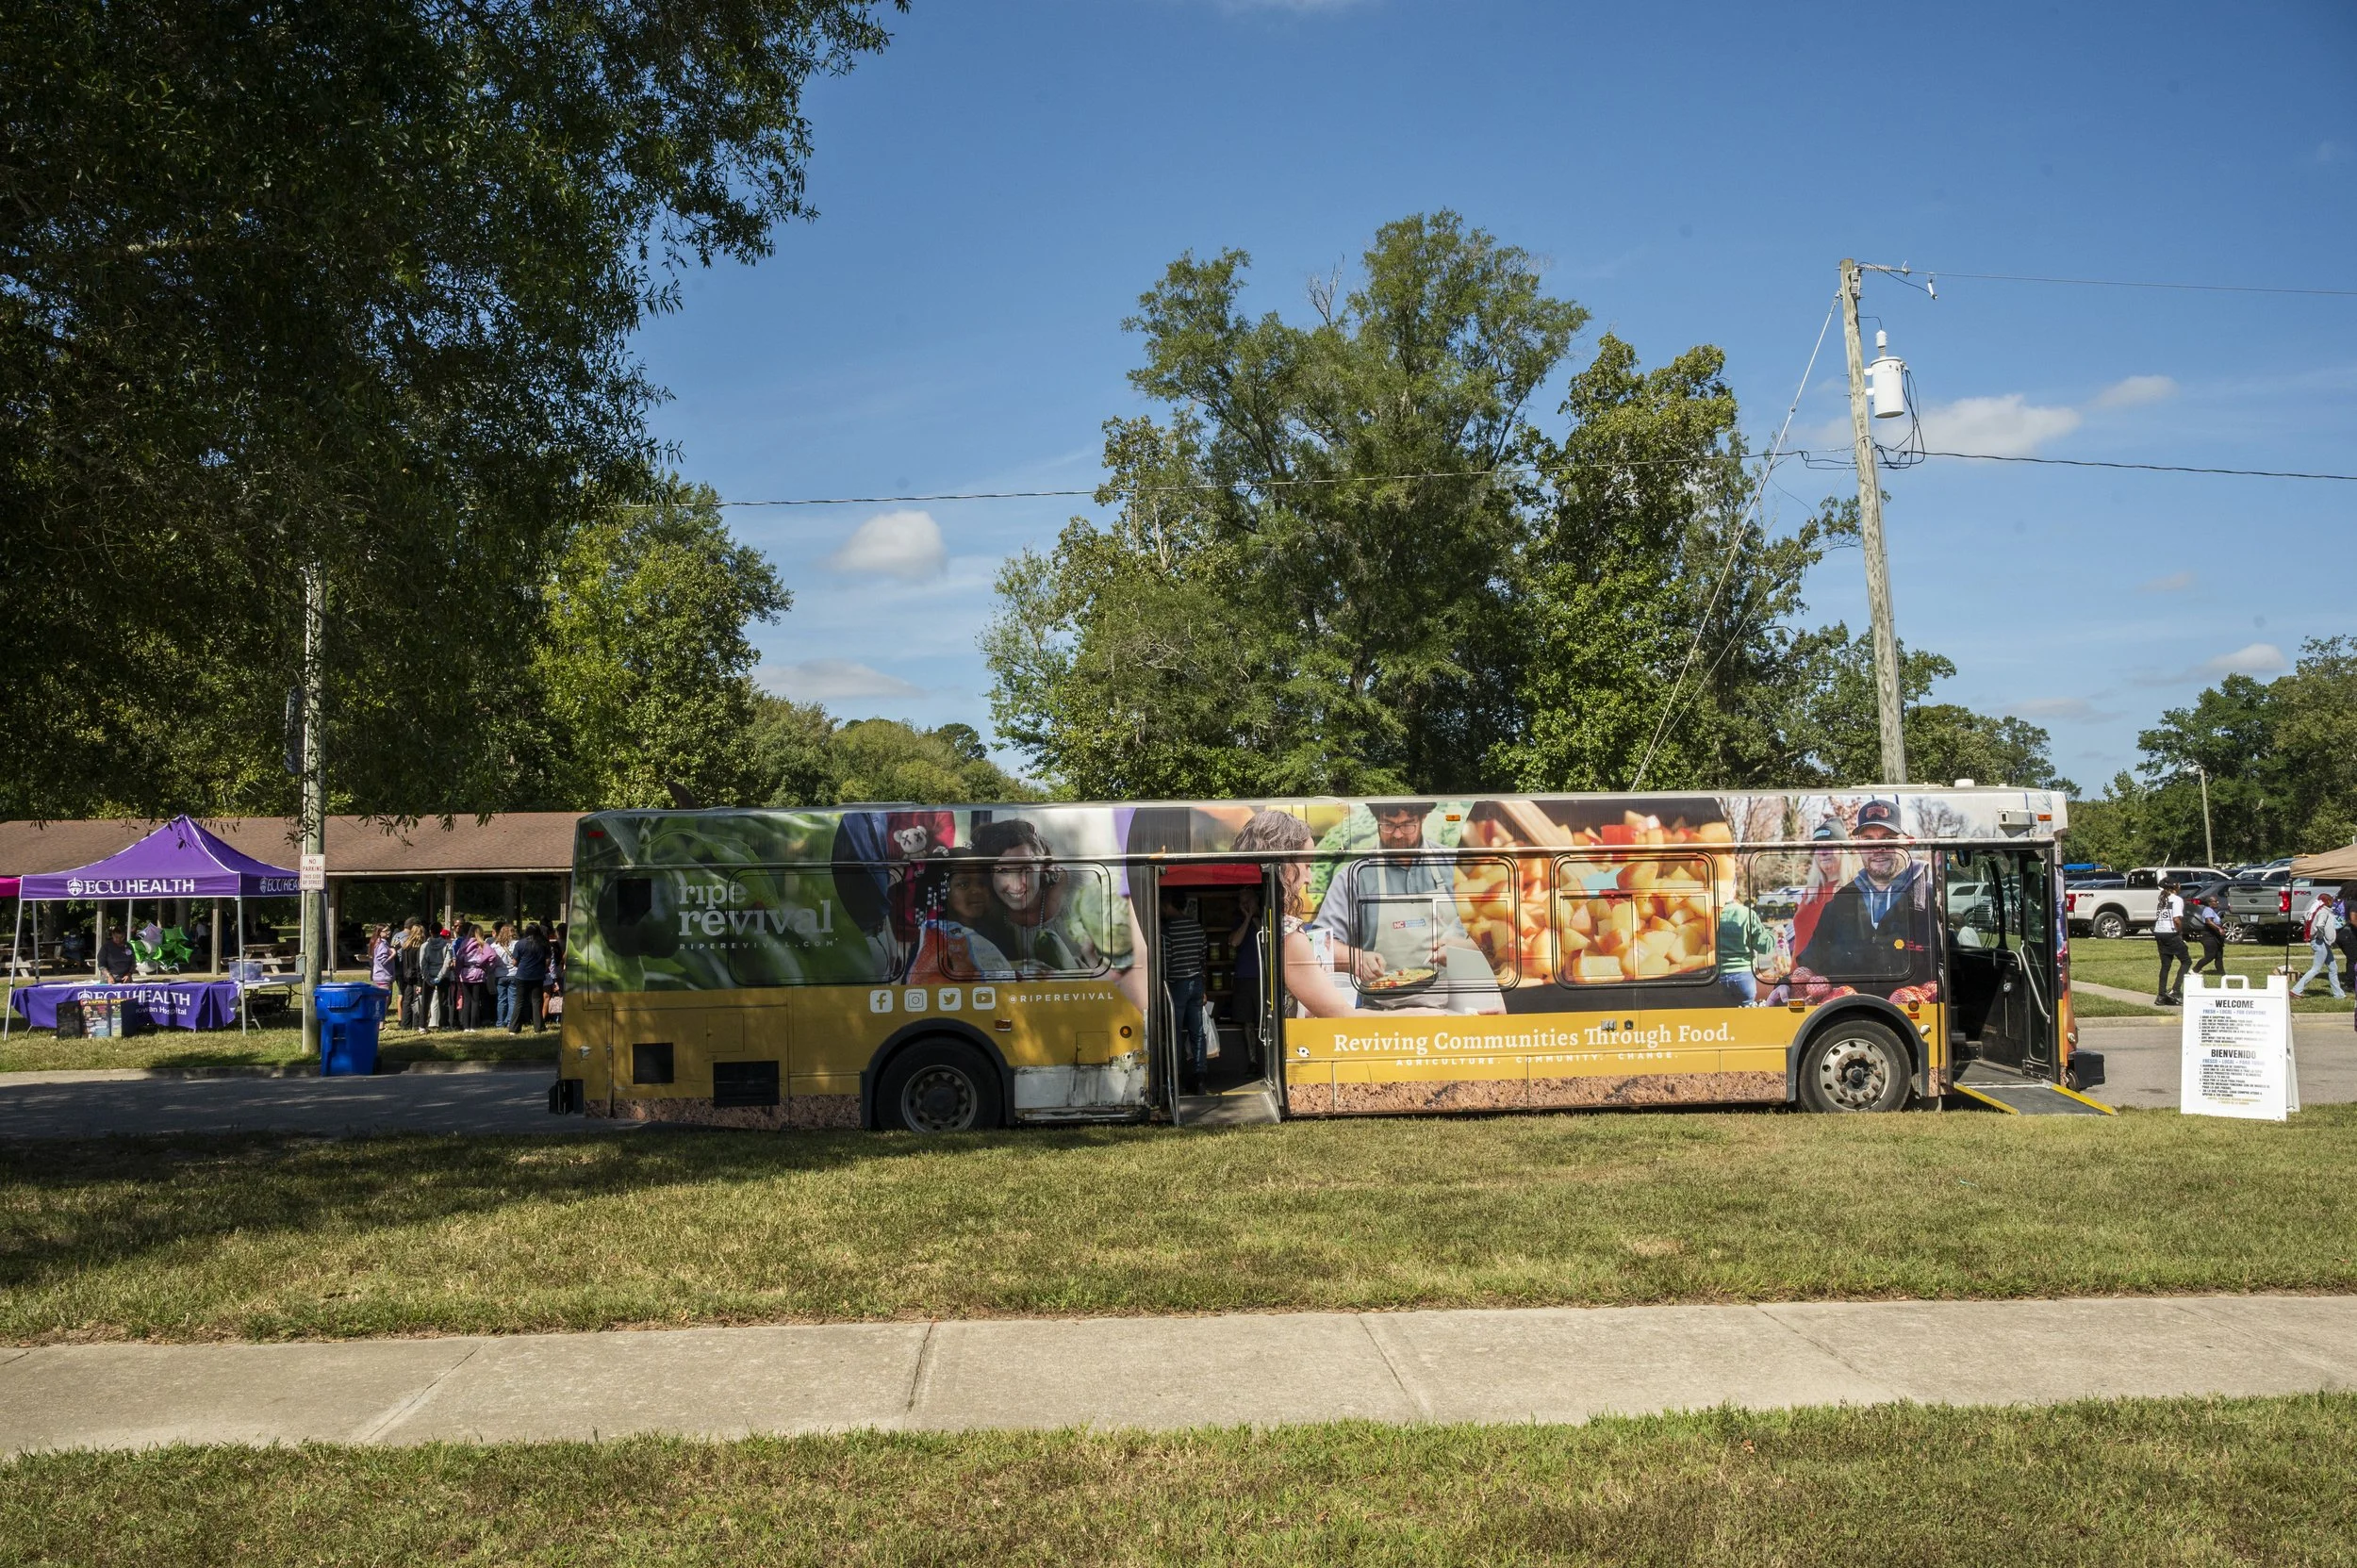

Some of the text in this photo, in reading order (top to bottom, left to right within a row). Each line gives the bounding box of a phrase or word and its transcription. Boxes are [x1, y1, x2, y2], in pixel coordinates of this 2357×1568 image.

[84, 879, 195, 894] ECU HEALTH
[267, 878, 283, 892] ECU
[678, 883, 749, 910] ripe
[678, 900, 834, 936] revival
[679, 940, 833, 950] RIPEREVIVAL.COM
[132, 990, 190, 1006] HEALTH
[1008, 992, 1114, 1004] @RIPEREVIVAL
[2215, 999, 2254, 1009] WELCOME
[1333, 1022, 1736, 1055] Reviving Communities Through Food.
[1395, 1051, 1678, 1066] AGRICULTURE. COMMUNITY. CHANGE.
[2211, 1049, 2256, 1059] BIENVENIDO
